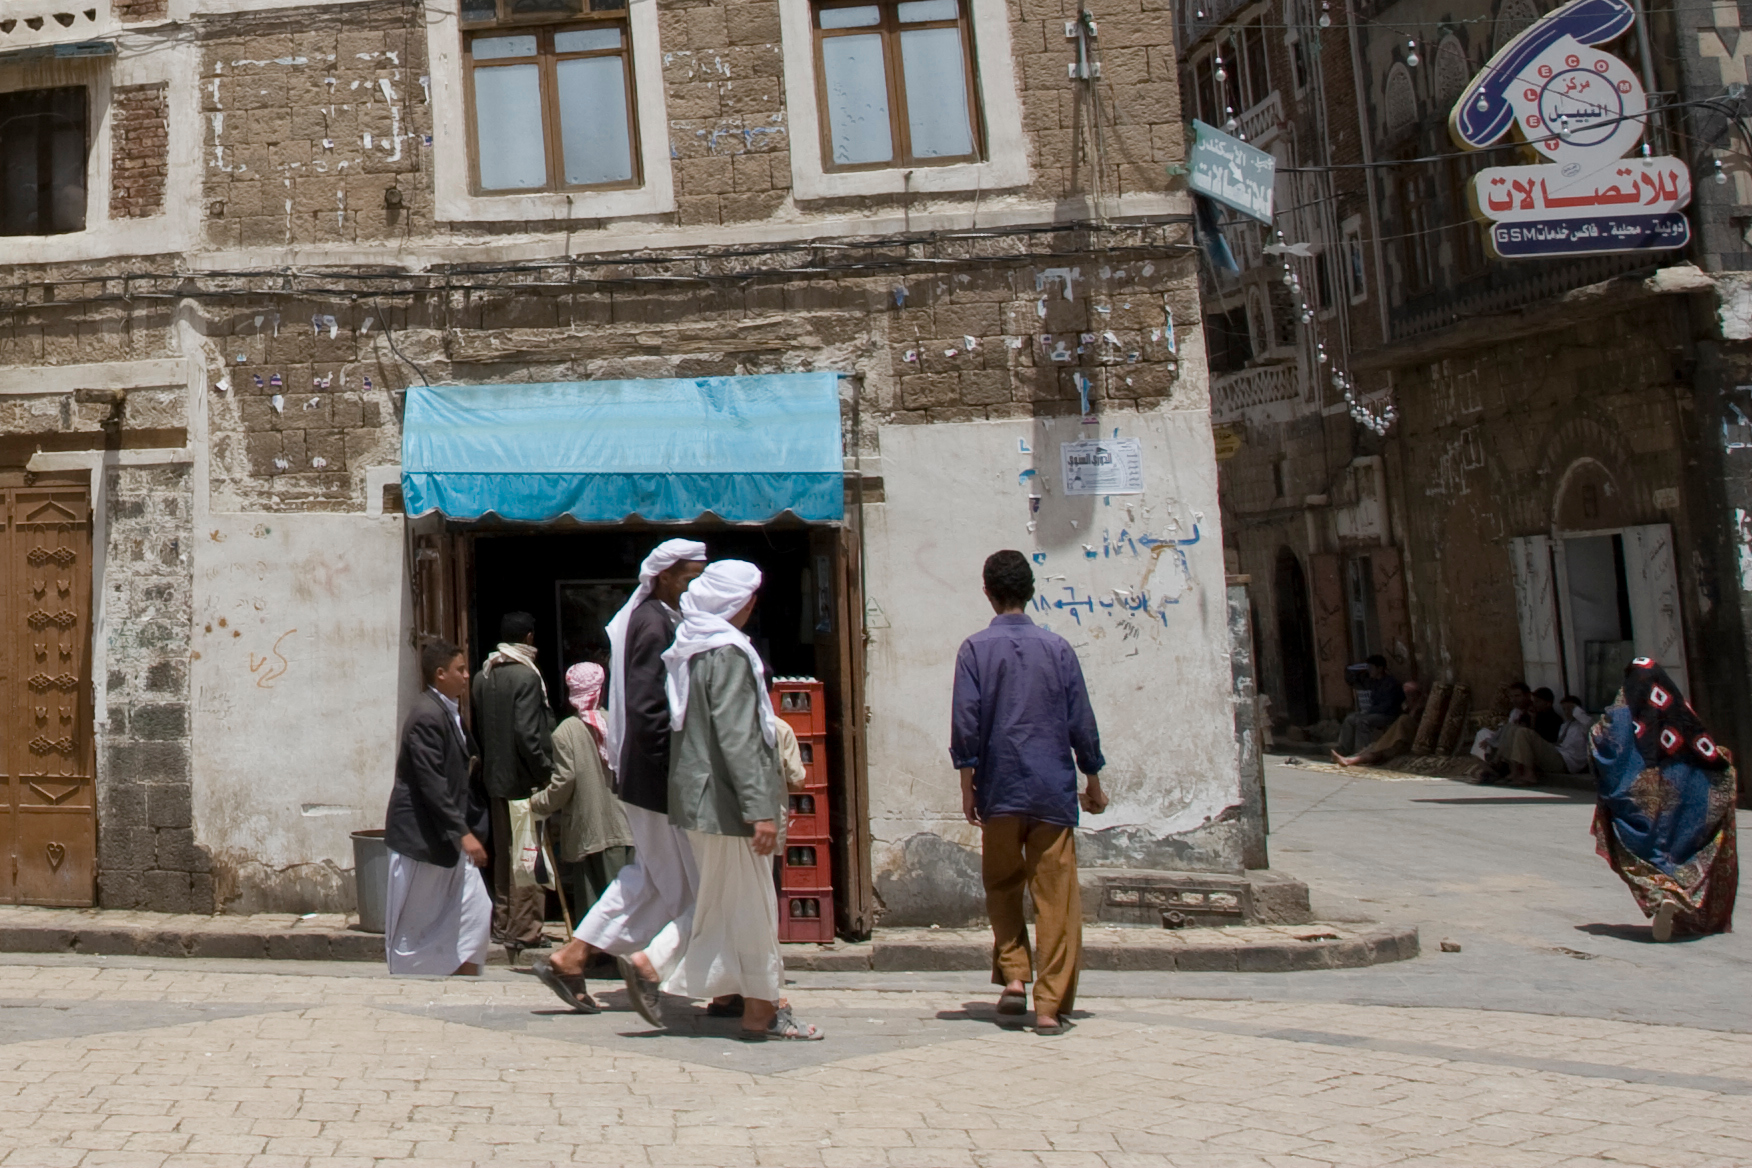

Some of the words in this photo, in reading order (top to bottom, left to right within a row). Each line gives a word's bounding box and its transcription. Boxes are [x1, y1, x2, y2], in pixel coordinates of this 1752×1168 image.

[1563, 76, 1591, 94] مركز
[1488, 168, 1679, 212] للاتصالات
[1498, 229, 1536, 243] GSM
[1536, 222, 1570, 240] خدمات
[1570, 223, 1598, 241] فاكس
[1609, 221, 1642, 239] محلية
[1652, 219, 1685, 237] دولية
